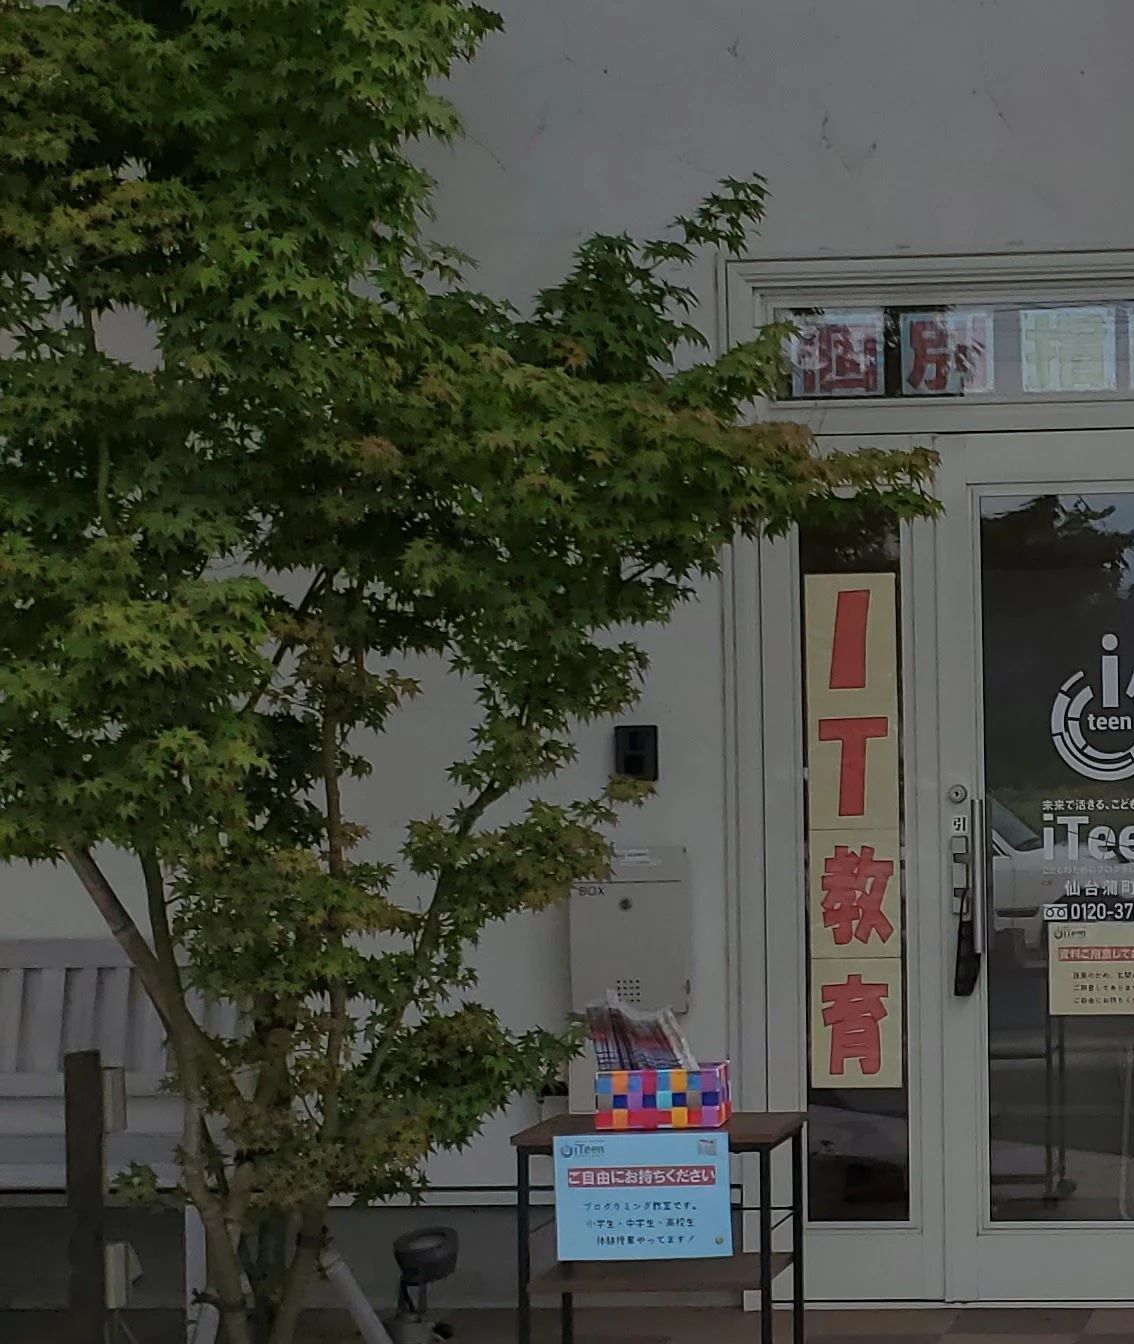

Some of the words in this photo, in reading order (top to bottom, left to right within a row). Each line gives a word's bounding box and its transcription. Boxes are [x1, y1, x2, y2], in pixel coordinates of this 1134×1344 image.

[1088, 713, 1132, 730] teen
[818, 589, 894, 1075] IT教育
[953, 817, 966, 831] 引
[574, 1142, 604, 1155] iTeen
[568, 1168, 715, 1185] ご自由にお持ちください
